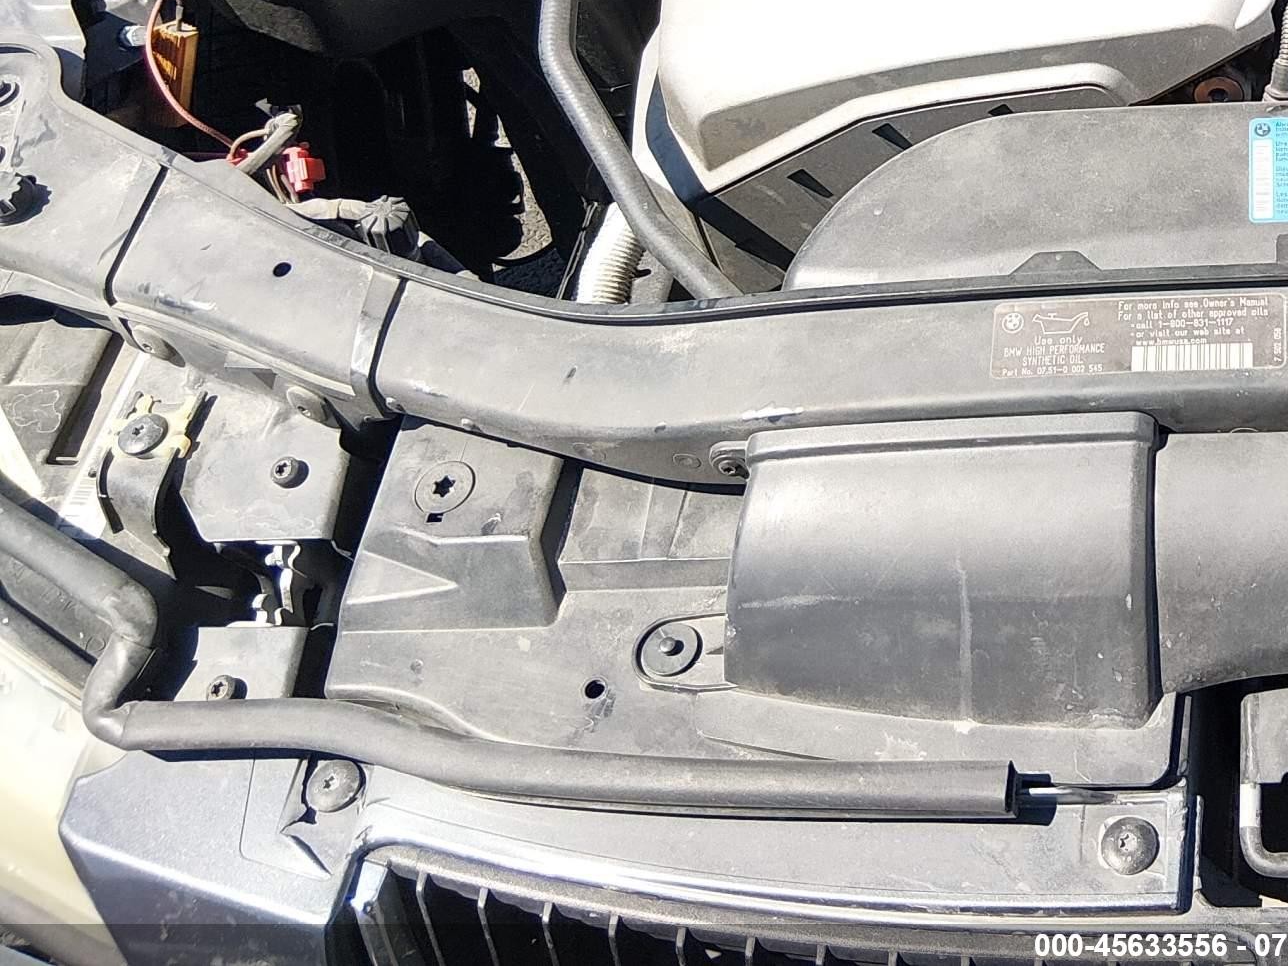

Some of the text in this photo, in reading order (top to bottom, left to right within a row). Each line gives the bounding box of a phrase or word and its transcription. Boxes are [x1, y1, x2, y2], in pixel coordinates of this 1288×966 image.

[1118, 300, 1133, 311] For
[1137, 302, 1158, 310] more
[1239, 296, 1269, 307] Manual
[1118, 310, 1132, 321] For
[1167, 309, 1177, 319] of
[1181, 308, 1204, 318] other
[1208, 307, 1247, 319] approved
[1150, 328, 1170, 337] visit
[1192, 326, 1210, 336] web
[1235, 325, 1245, 335] at
[1034, 334, 1083, 346] Use only
[1135, 337, 1208, 346] www.bmwusa.com
[1003, 342, 1105, 358] BMW HIGH PERFORMANCE
[1022, 354, 1084, 366] SYNTHETIC OIL
[1002, 367, 1018, 376] Part
[1021, 366, 1034, 375] No.
